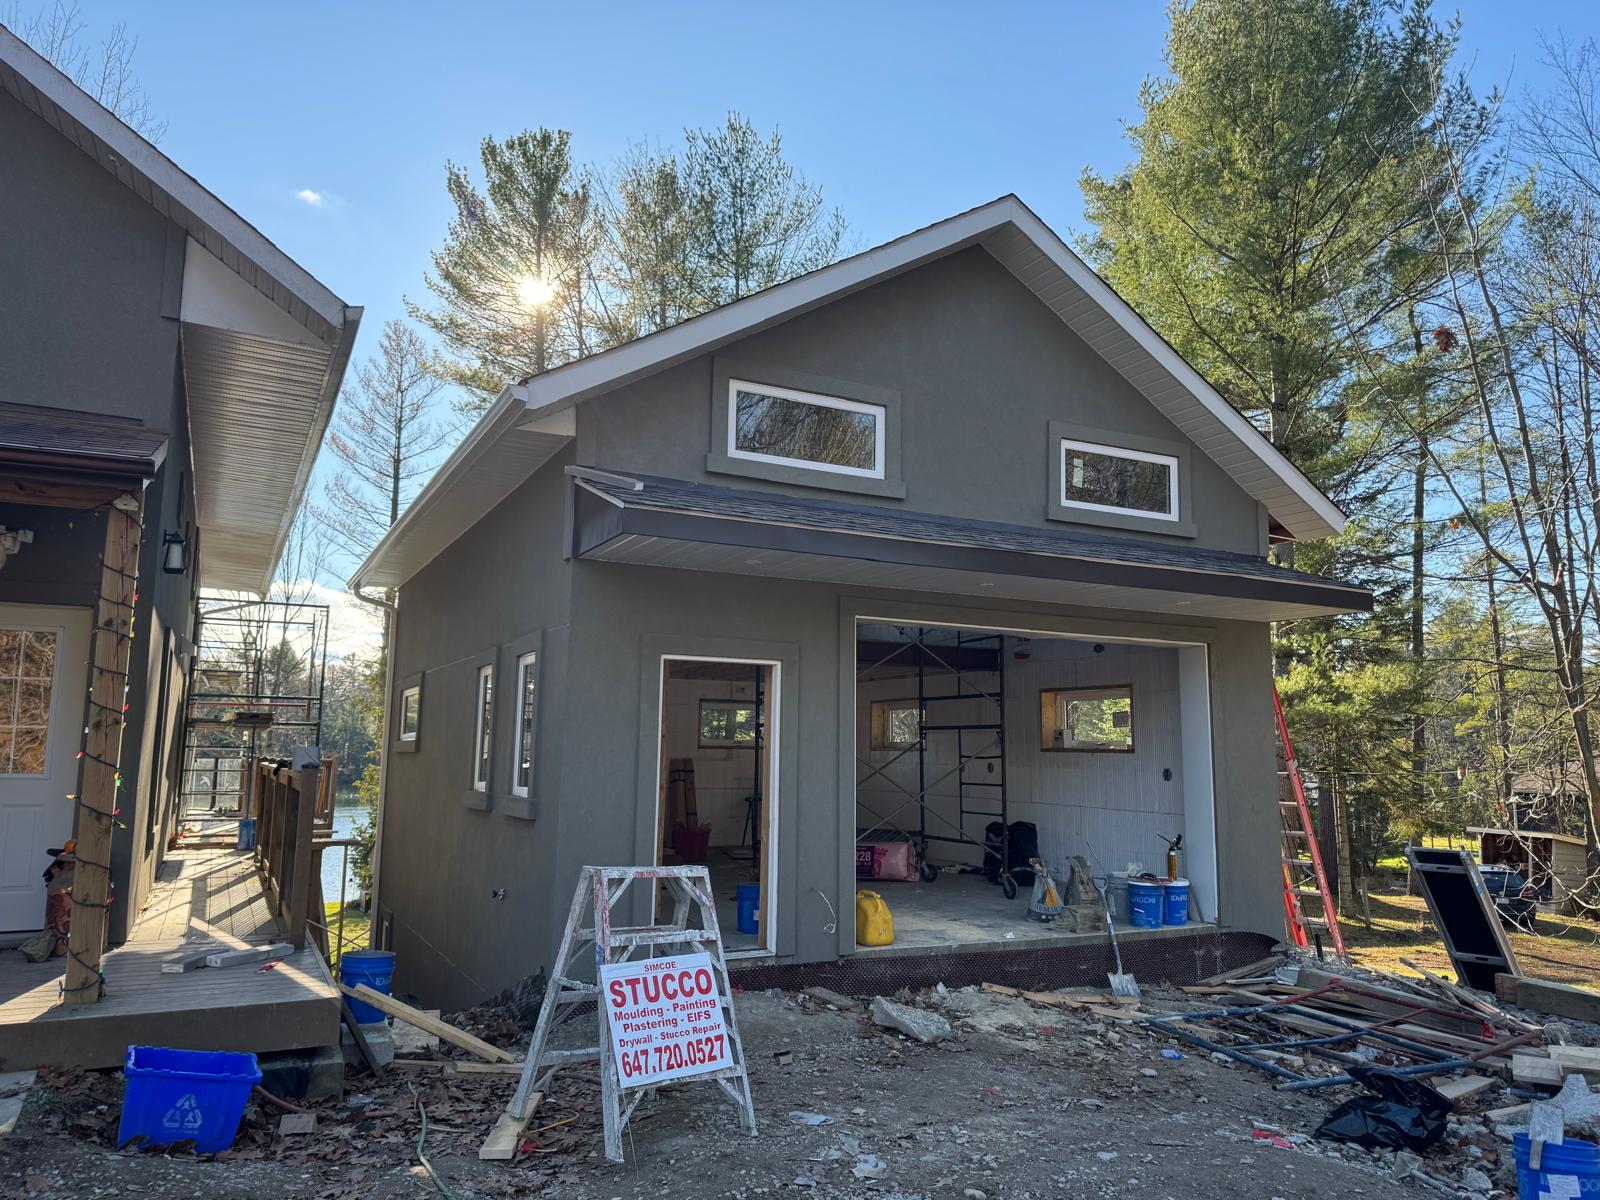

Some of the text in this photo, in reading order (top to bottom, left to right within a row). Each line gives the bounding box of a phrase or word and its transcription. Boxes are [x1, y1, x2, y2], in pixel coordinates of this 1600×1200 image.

[644, 961, 677, 972] SIMCOE
[609, 968, 712, 1008] STUCCO
[614, 1006, 664, 1022] Moulding
[673, 998, 716, 1012] Painting
[623, 1016, 678, 1033] Plastering
[687, 1010, 712, 1023] EIFS
[619, 1034, 653, 1048] Drywall
[660, 1028, 690, 1040] Stucco
[692, 1022, 721, 1034] Repair
[621, 1033, 725, 1078] 647.720.0527
